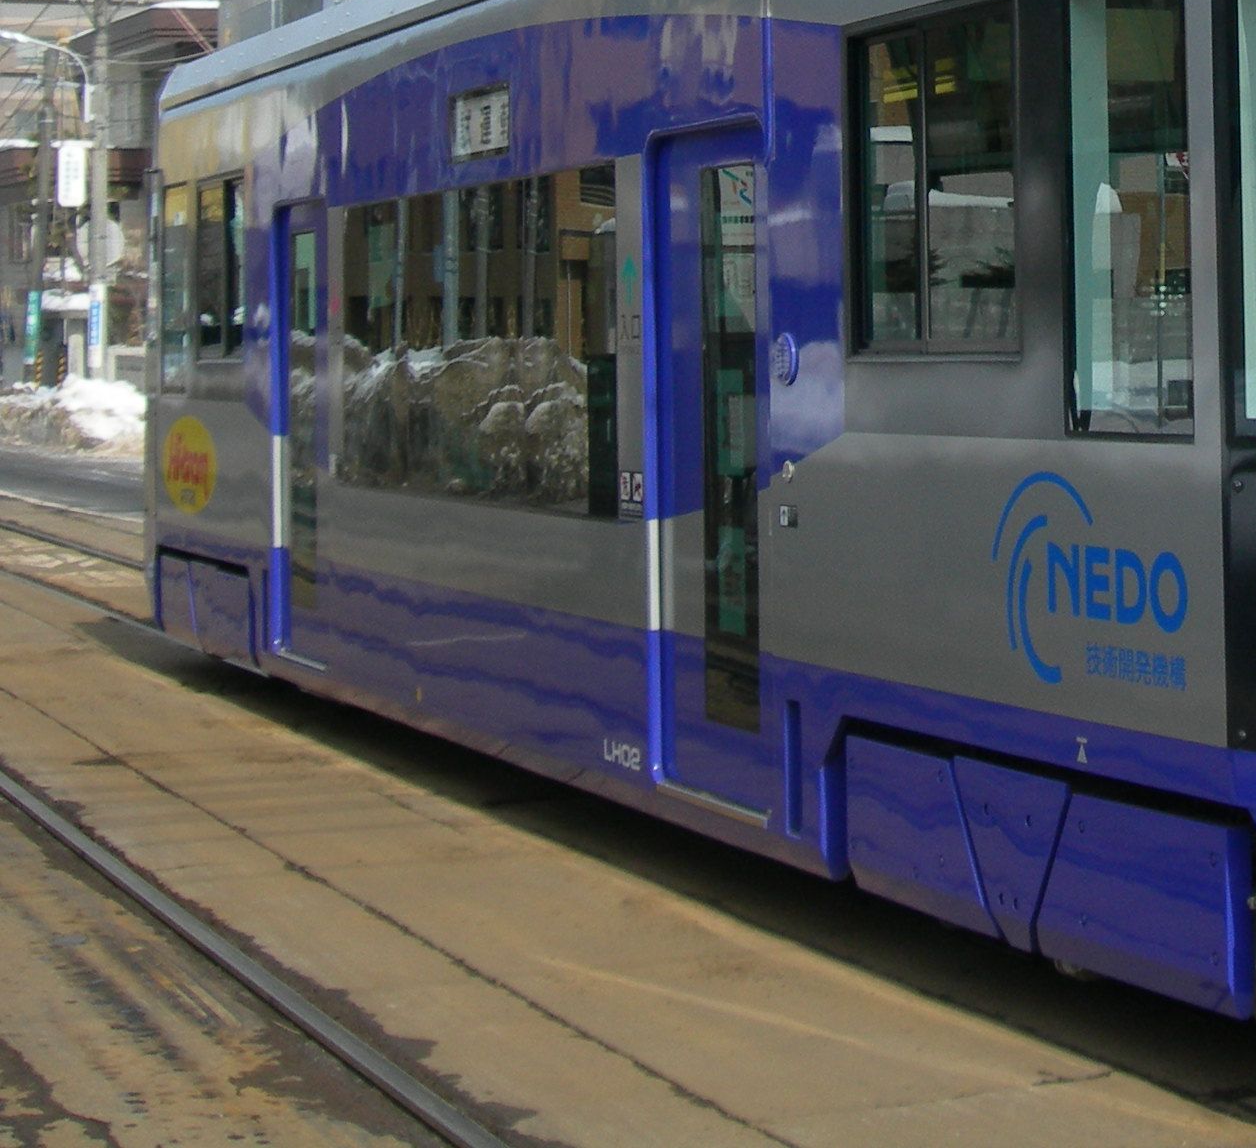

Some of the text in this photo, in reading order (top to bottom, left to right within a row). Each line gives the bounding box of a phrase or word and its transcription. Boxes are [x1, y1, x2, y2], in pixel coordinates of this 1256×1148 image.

[1047, 541, 1188, 633] NEDO
[1085, 642, 1187, 692] 技術開発機構
[603, 738, 641, 771] LH02
